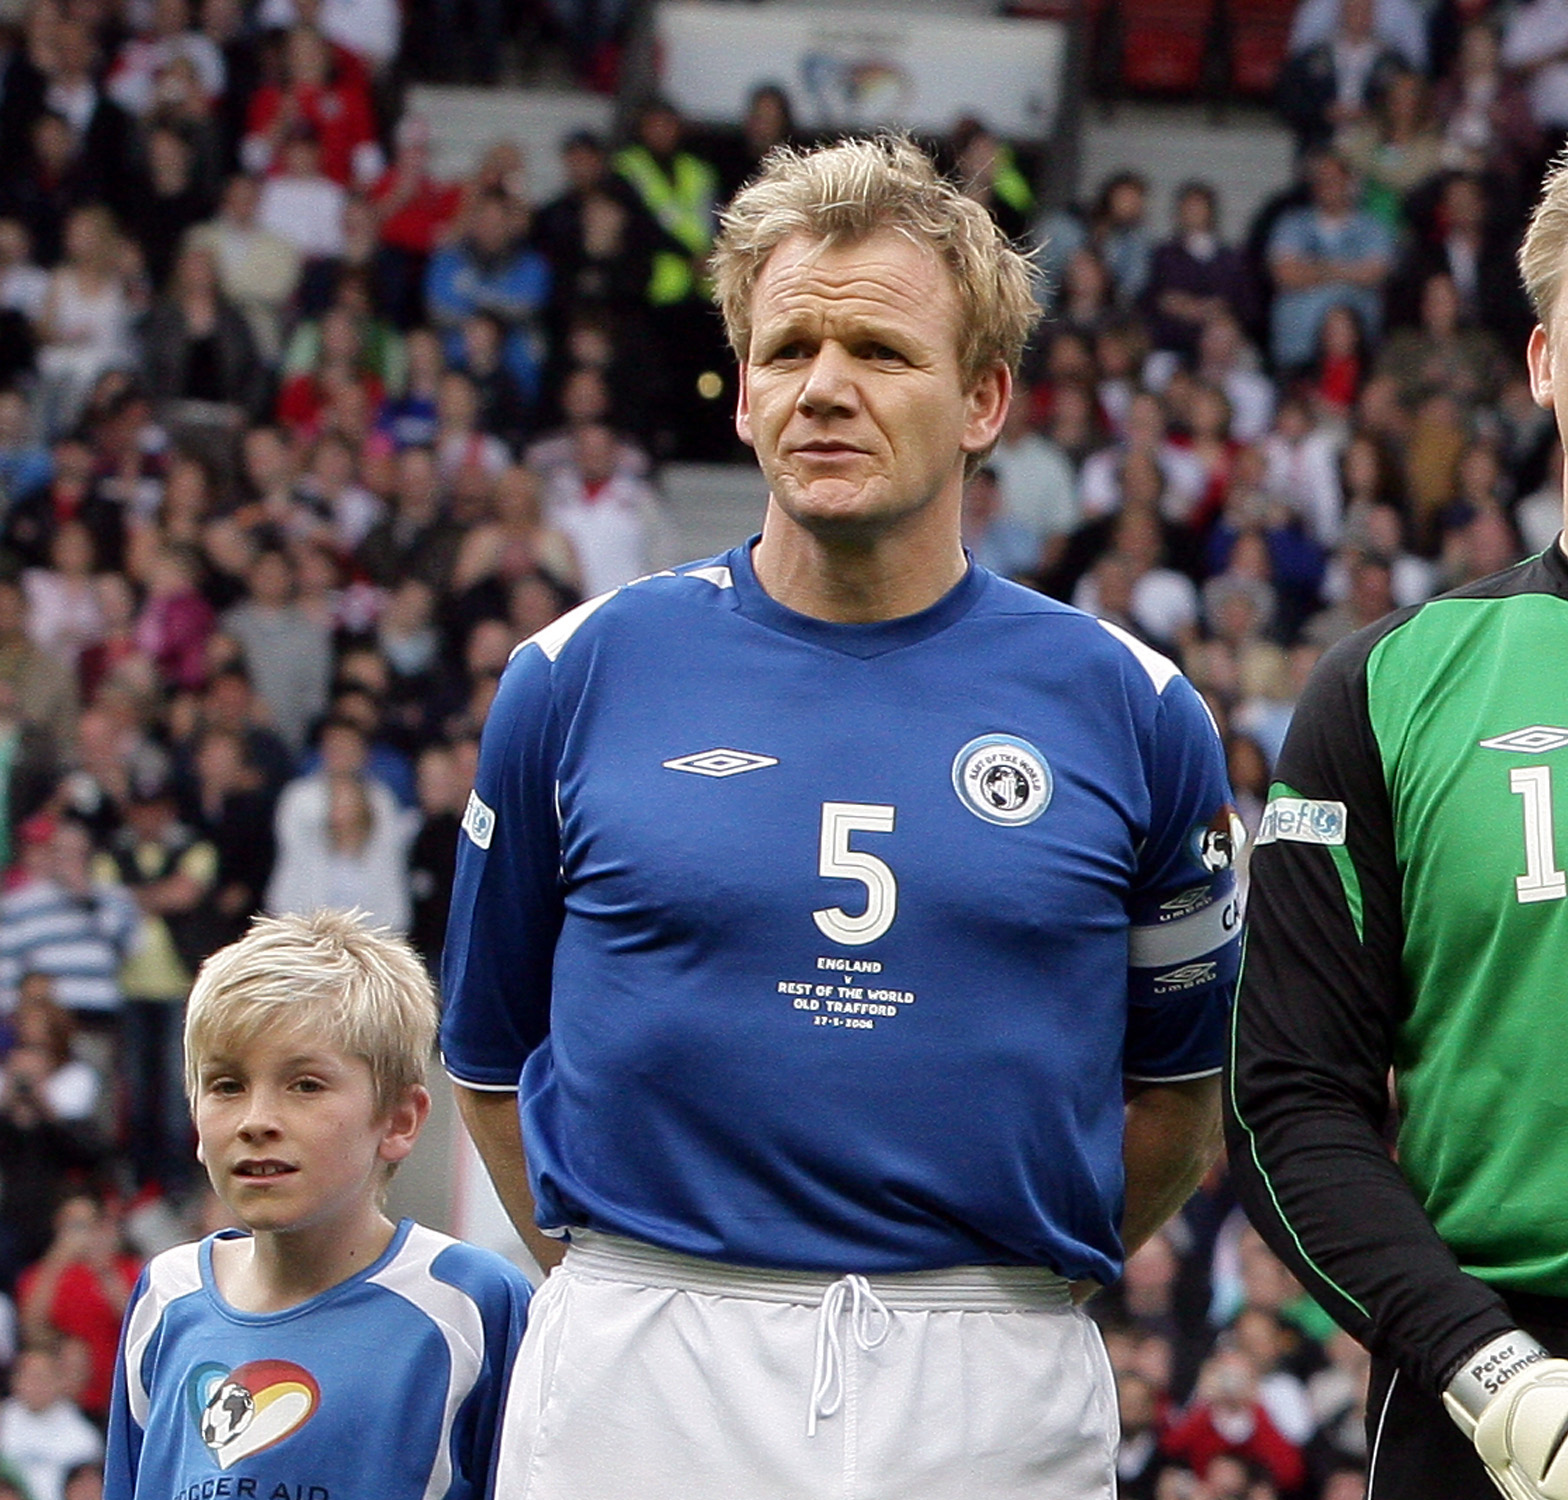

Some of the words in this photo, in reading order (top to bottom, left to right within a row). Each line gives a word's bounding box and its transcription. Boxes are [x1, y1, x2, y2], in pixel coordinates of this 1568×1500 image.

[1508, 764, 1568, 904] 1
[811, 801, 898, 947] 5
[816, 957, 882, 974] ENGLAND
[777, 981, 813, 996] REST
[815, 984, 834, 997] OF
[837, 986, 864, 1000] THE
[866, 988, 916, 1004] WORLD
[792, 997, 820, 1011] OLD
[825, 1000, 898, 1017] TRAFFORD
[1470, 1344, 1516, 1382] Peter
